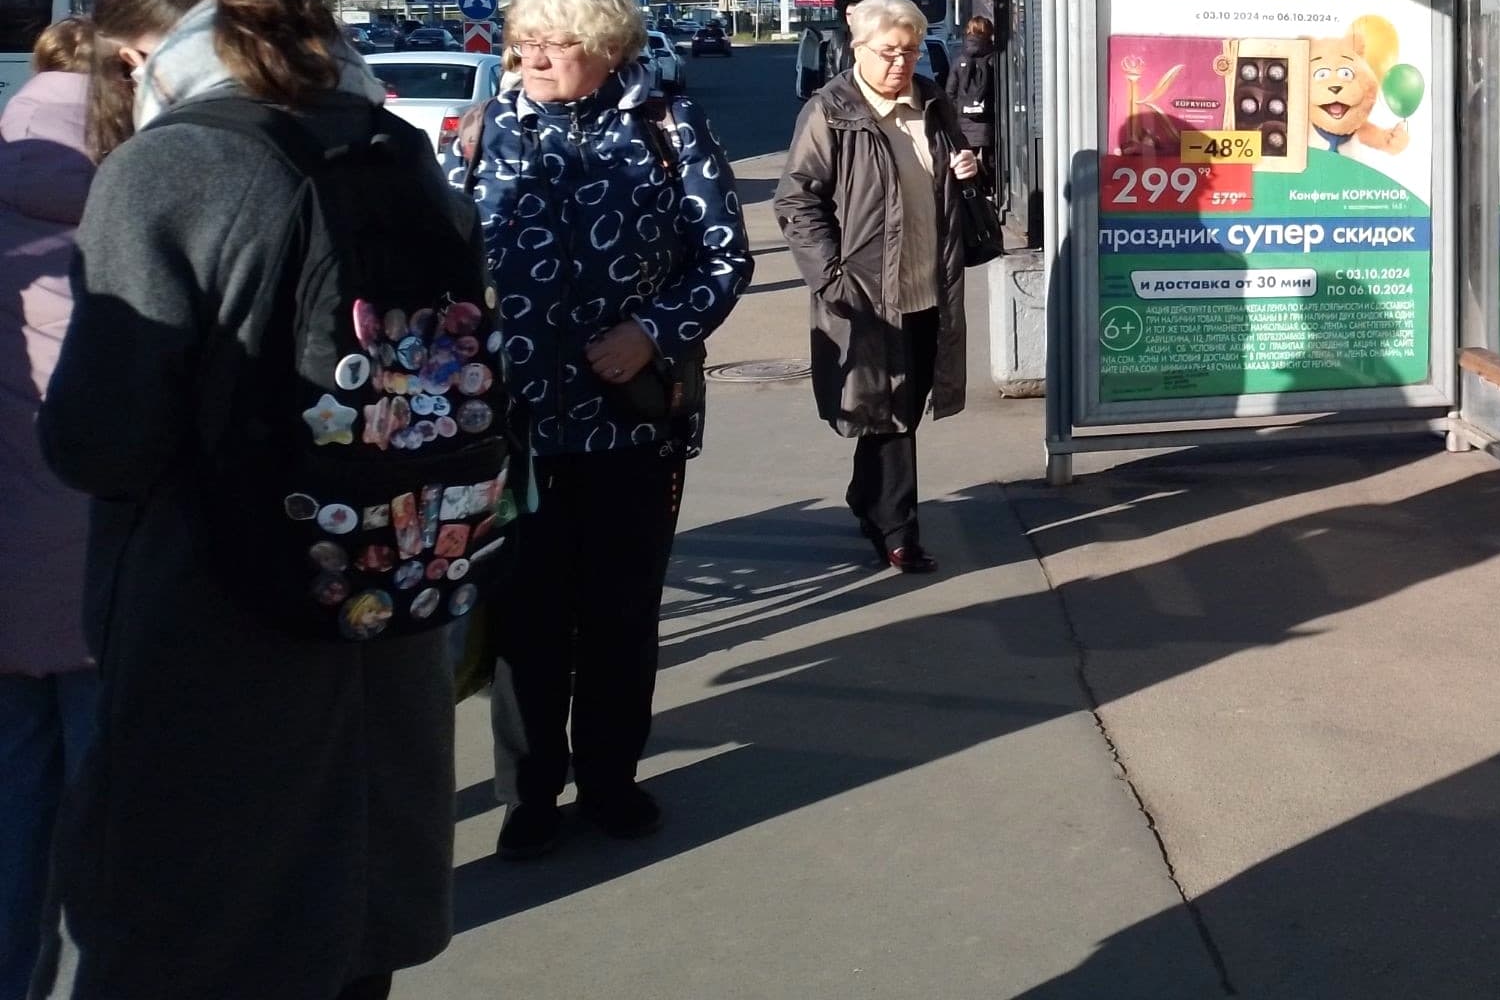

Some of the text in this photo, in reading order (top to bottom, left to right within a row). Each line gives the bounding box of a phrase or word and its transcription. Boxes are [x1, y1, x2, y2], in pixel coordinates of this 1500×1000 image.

[1277, 13, 1332, 22] 06.10.2024
[1111, 167, 1197, 204] 299
[1289, 189, 1409, 203] Конфеты КОРКУНОВ,
[1099, 221, 1416, 253] праздник супер скидок
[1335, 268, 1410, 280] С 03.10.2024
[1140, 275, 1311, 291] и доставка от 30 мин
[1327, 284, 1413, 295] ПО 06.10.2024
[1104, 318, 1135, 339] 6+
